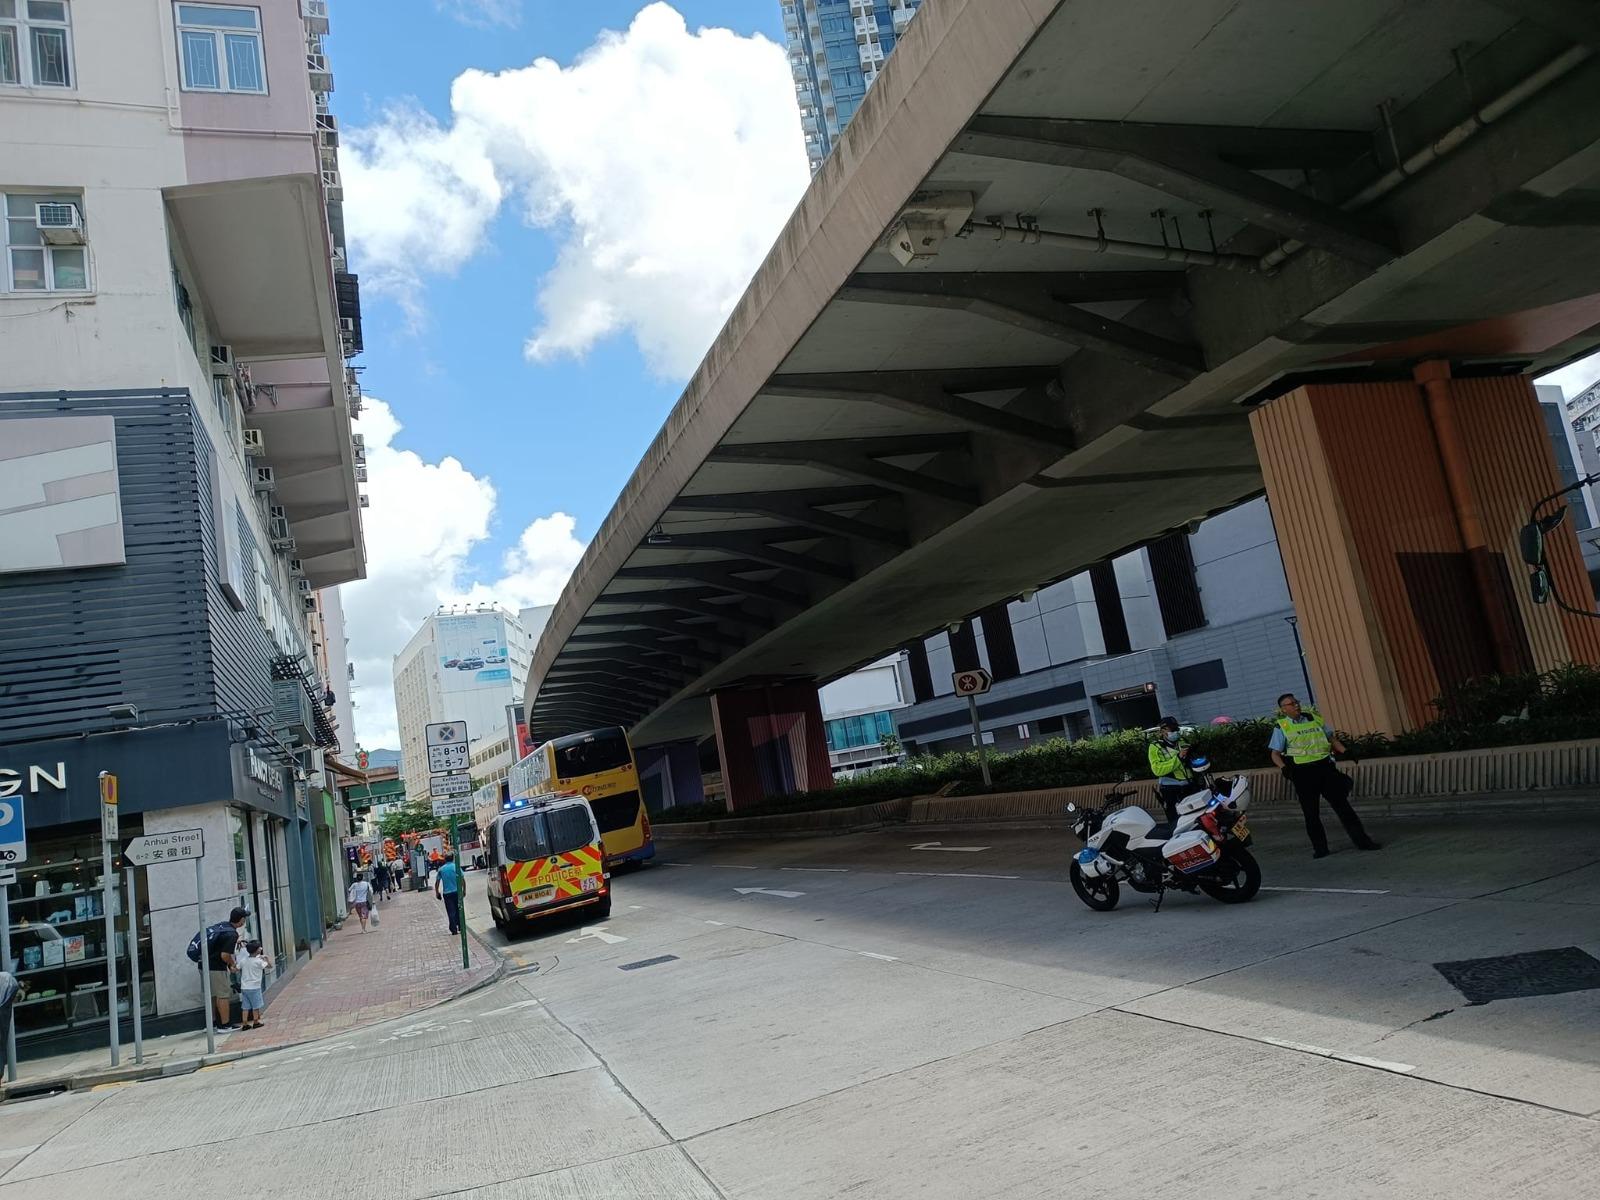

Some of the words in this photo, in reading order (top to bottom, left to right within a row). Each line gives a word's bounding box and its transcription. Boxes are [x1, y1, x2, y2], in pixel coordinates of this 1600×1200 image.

[443, 745, 466, 756] 8-10
[445, 757, 463, 767] 5-7
[144, 838, 169, 847] Anhui
[171, 833, 200, 843] Street
[538, 869, 575, 885] POLICE
